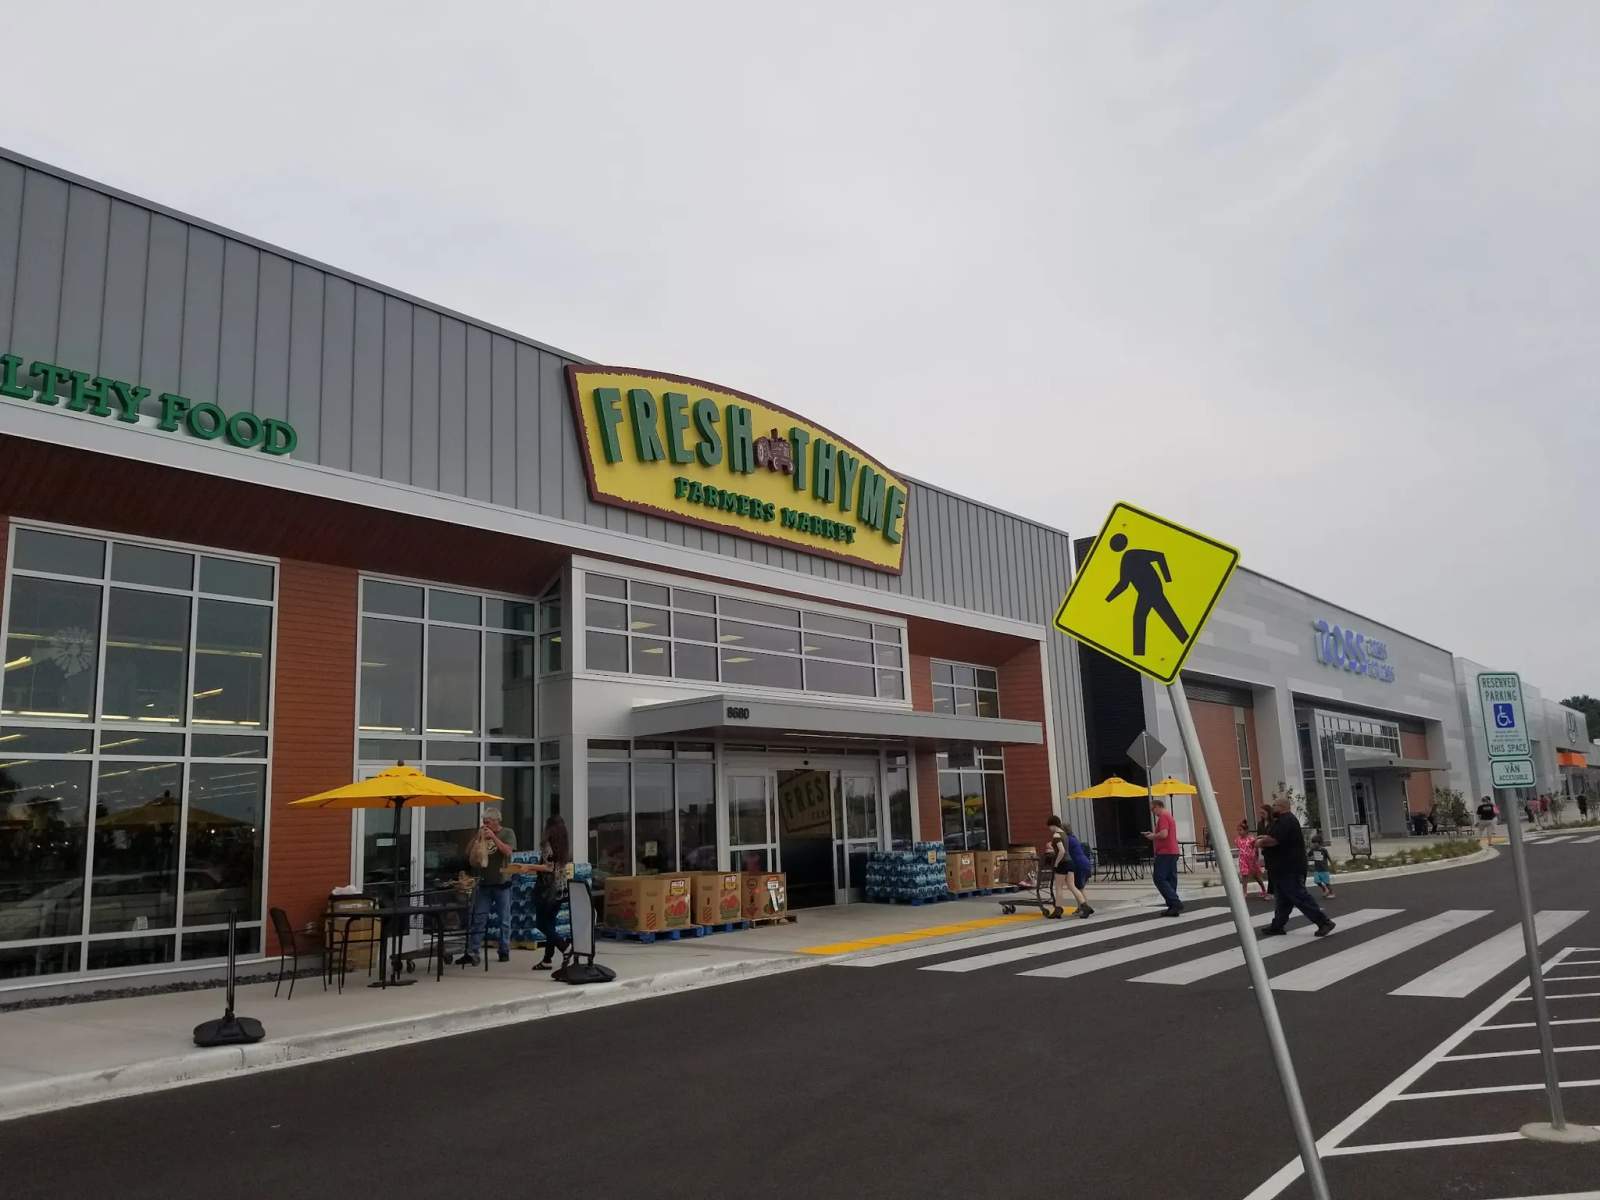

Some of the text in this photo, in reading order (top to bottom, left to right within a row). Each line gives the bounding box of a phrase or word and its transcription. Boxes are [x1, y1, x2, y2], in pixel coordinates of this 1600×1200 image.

[0, 354, 298, 456] LTHY FOOD
[593, 386, 906, 545] FRESH THYME
[674, 476, 857, 544] FARMERS MARKET
[1481, 677, 1517, 688] RESERVED
[1485, 690, 1517, 701] PARKING
[1490, 743, 1527, 753] THIS SPACE
[1504, 762, 1520, 773] VAN
